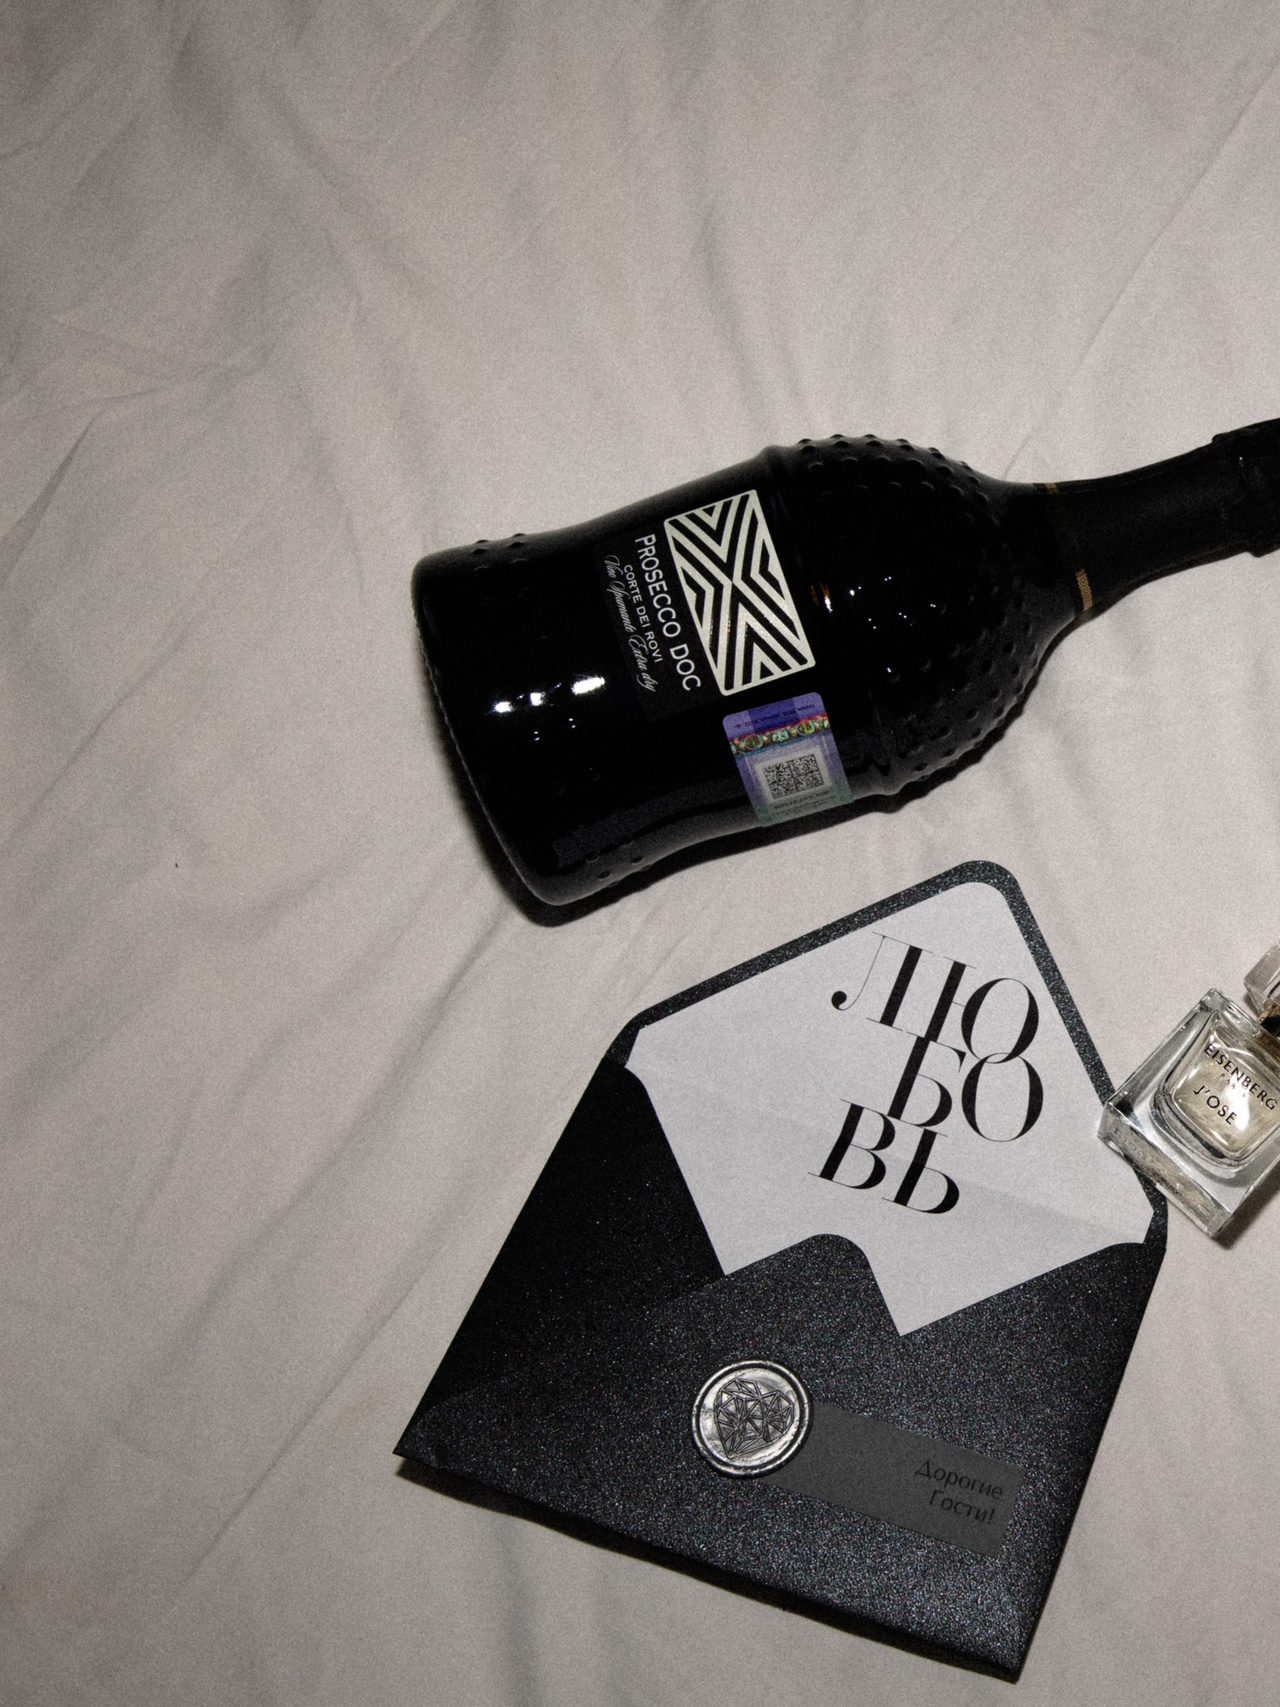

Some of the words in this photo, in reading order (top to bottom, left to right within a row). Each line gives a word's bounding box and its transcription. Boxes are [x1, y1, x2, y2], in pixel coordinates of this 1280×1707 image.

[603, 554, 624, 579] Vino
[606, 580, 637, 634] Spumante
[623, 564, 642, 604] CORTE
[636, 605, 651, 628] DEI
[644, 631, 664, 663] ROVI
[635, 534, 681, 638] PROSECCO
[669, 643, 701, 691] DOC
[628, 634, 650, 673] Extra
[636, 671, 659, 693] dry
[1203, 1042, 1278, 1111] EISENBERG
[1220, 1072, 1247, 1098] PAR
[1192, 1084, 1238, 1126] J'OSE
[914, 1459, 1004, 1500] Дорогие
[929, 1488, 996, 1525] Гости!
